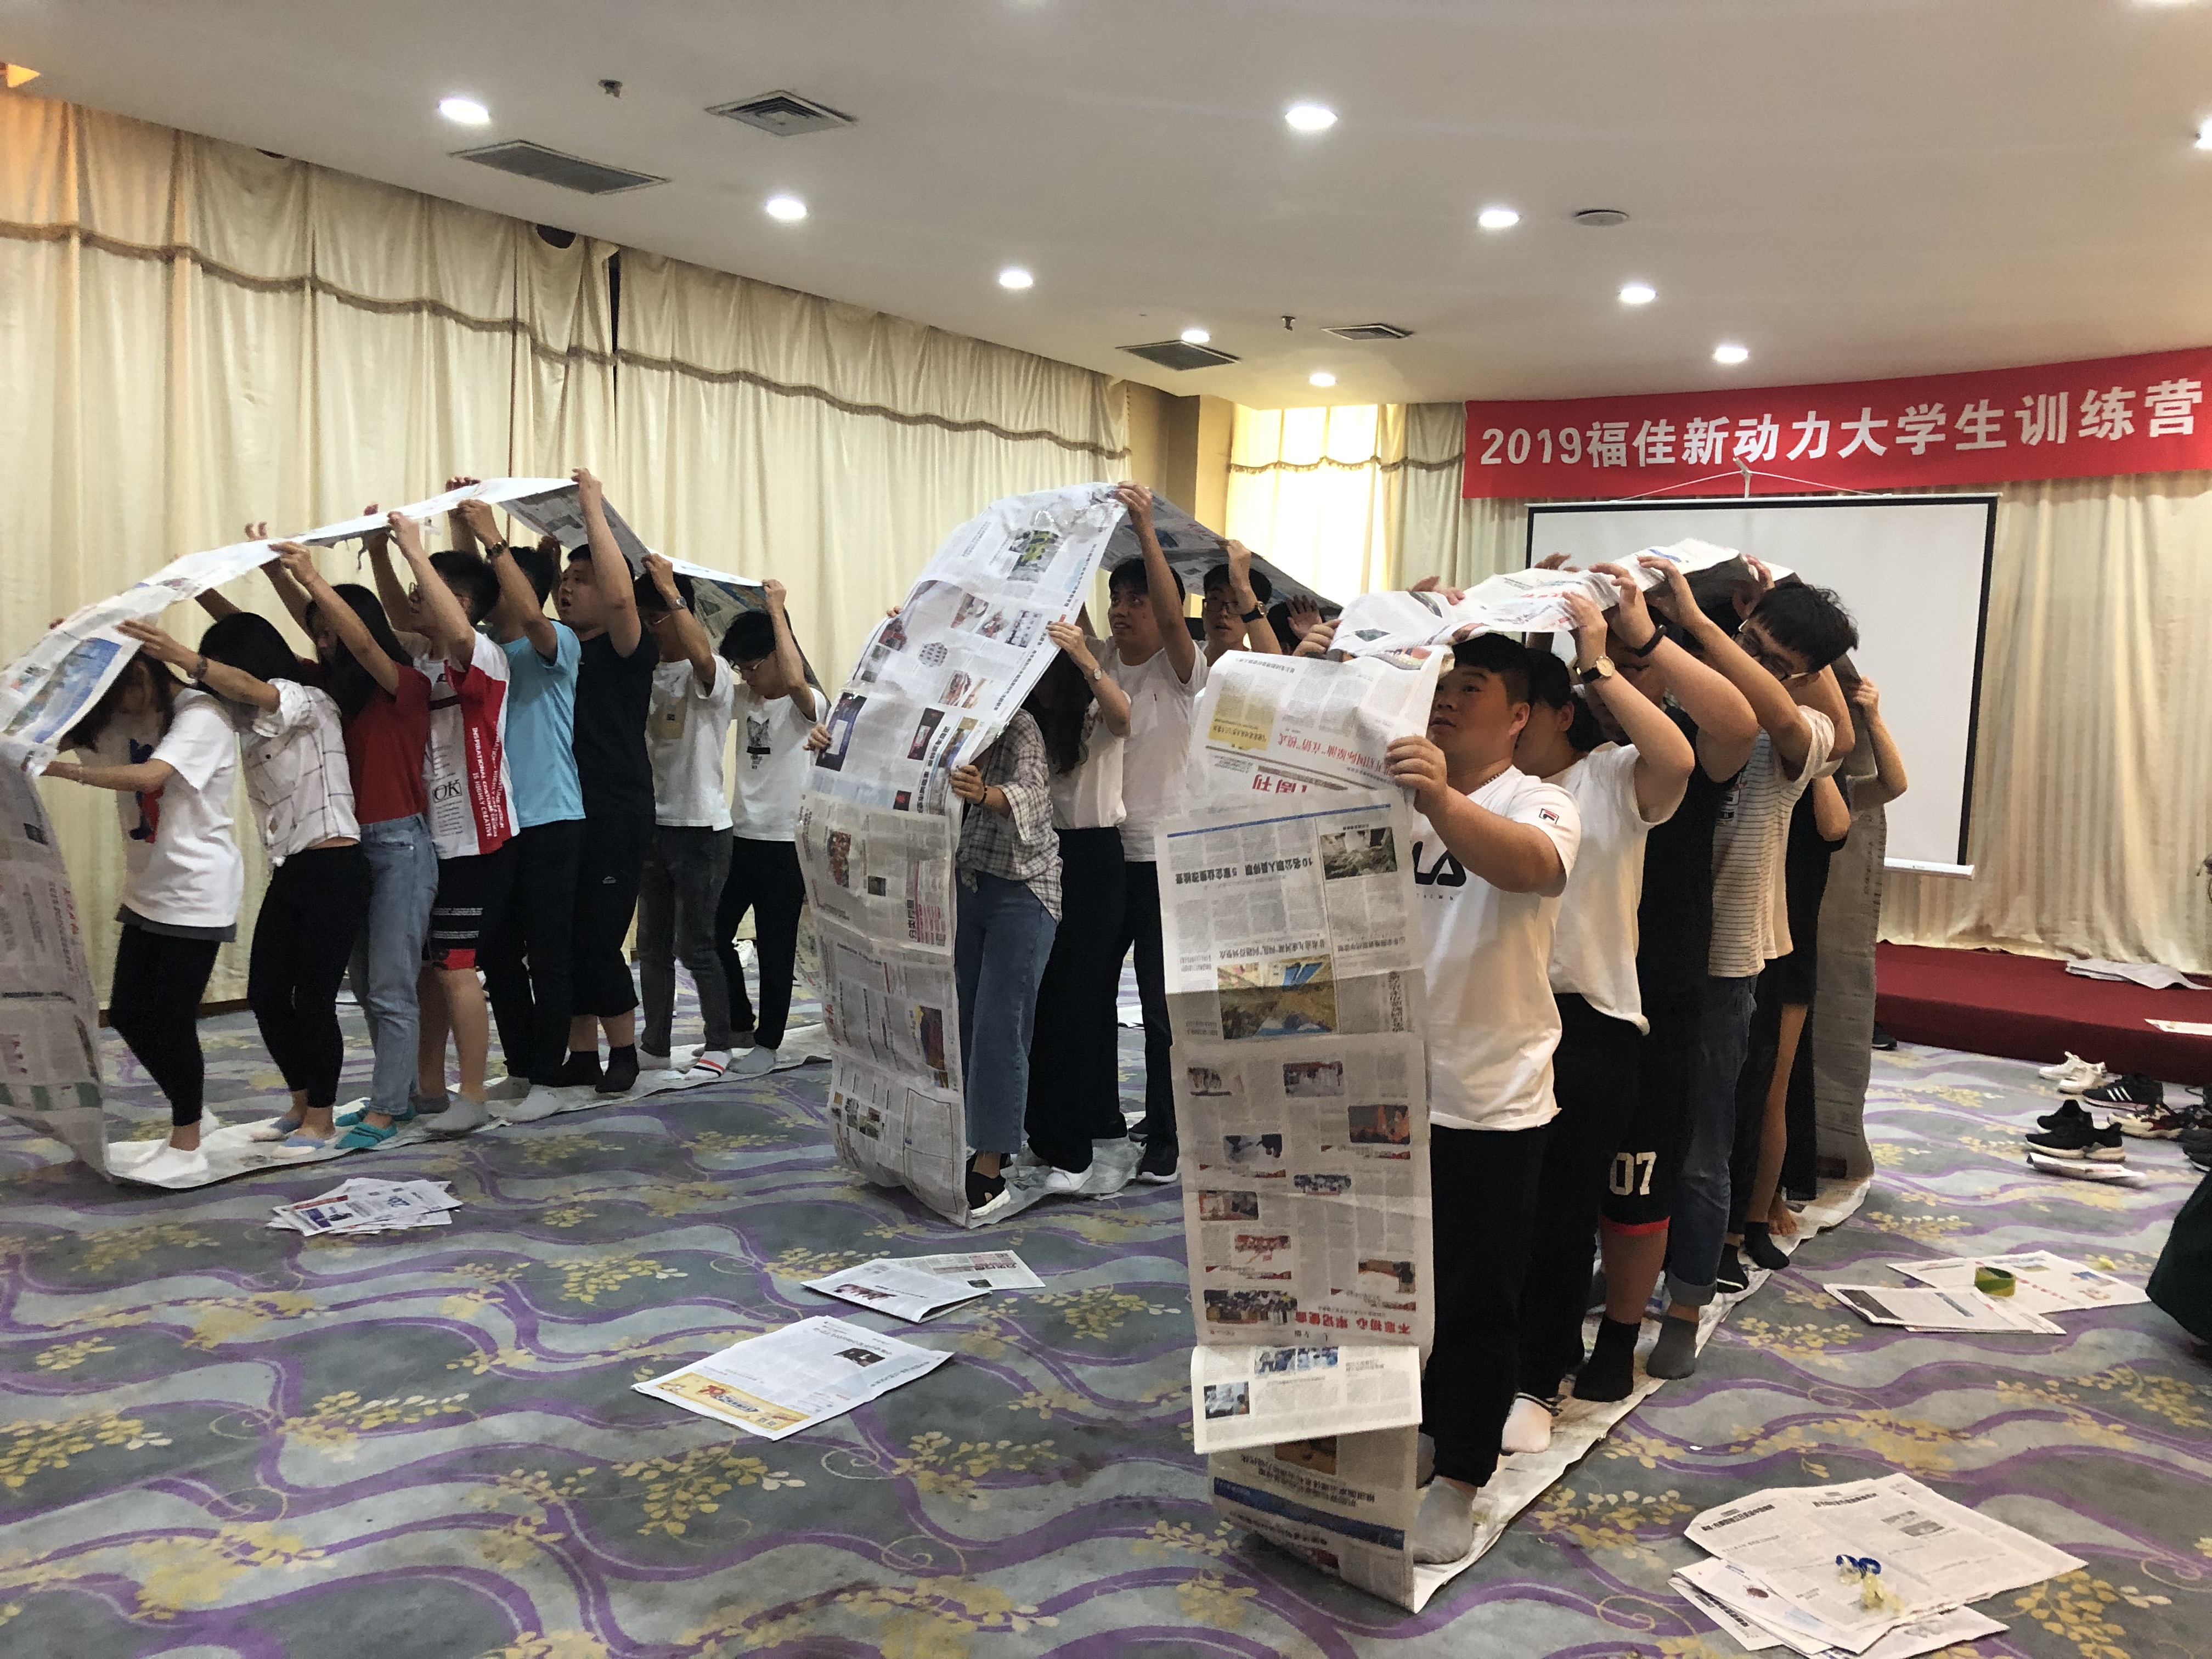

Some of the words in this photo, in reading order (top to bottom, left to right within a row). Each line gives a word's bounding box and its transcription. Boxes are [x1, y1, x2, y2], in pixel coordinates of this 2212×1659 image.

[1480, 377, 2204, 469] 2019福佳新动力大学生训练营
[434, 779, 459, 801] OK
[1252, 774, 1307, 793] 周刊
[1412, 840, 1467, 887] LA
[1609, 1151, 1657, 1195] 07
